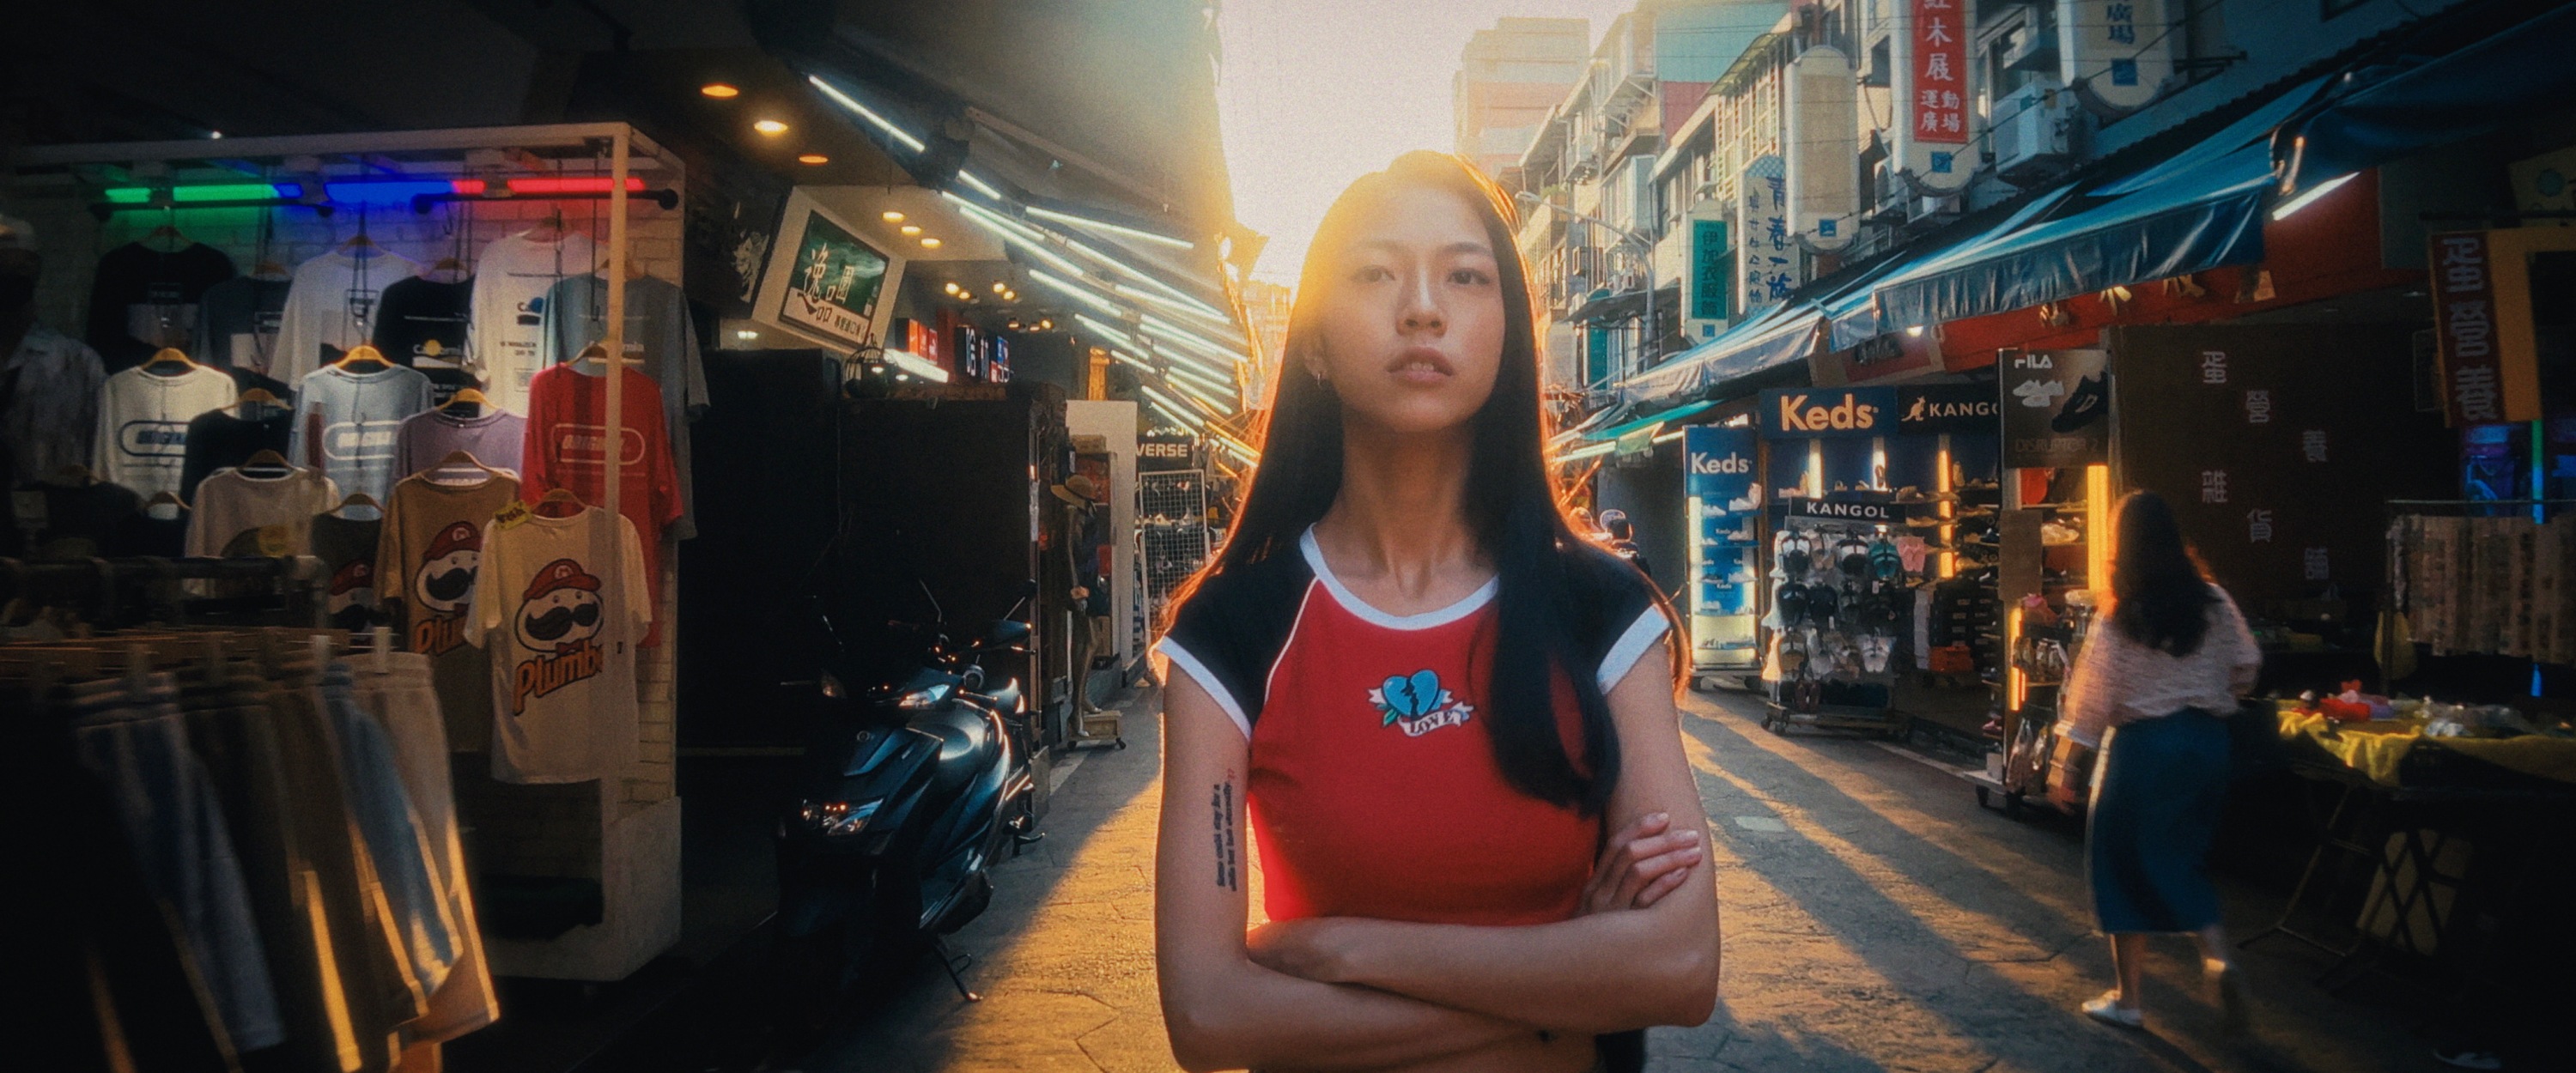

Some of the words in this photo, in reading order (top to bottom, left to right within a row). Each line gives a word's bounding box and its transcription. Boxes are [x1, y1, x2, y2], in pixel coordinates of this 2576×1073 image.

[1920, 90, 1959, 109] 運動
[1920, 112, 1960, 133] 廣場
[2014, 355, 2053, 369] FILA
[1780, 393, 1875, 431] Keds
[1691, 452, 1750, 474] Keds
[1807, 502, 1889, 518] KANGOL
[1409, 710, 1455, 734] LOVE
